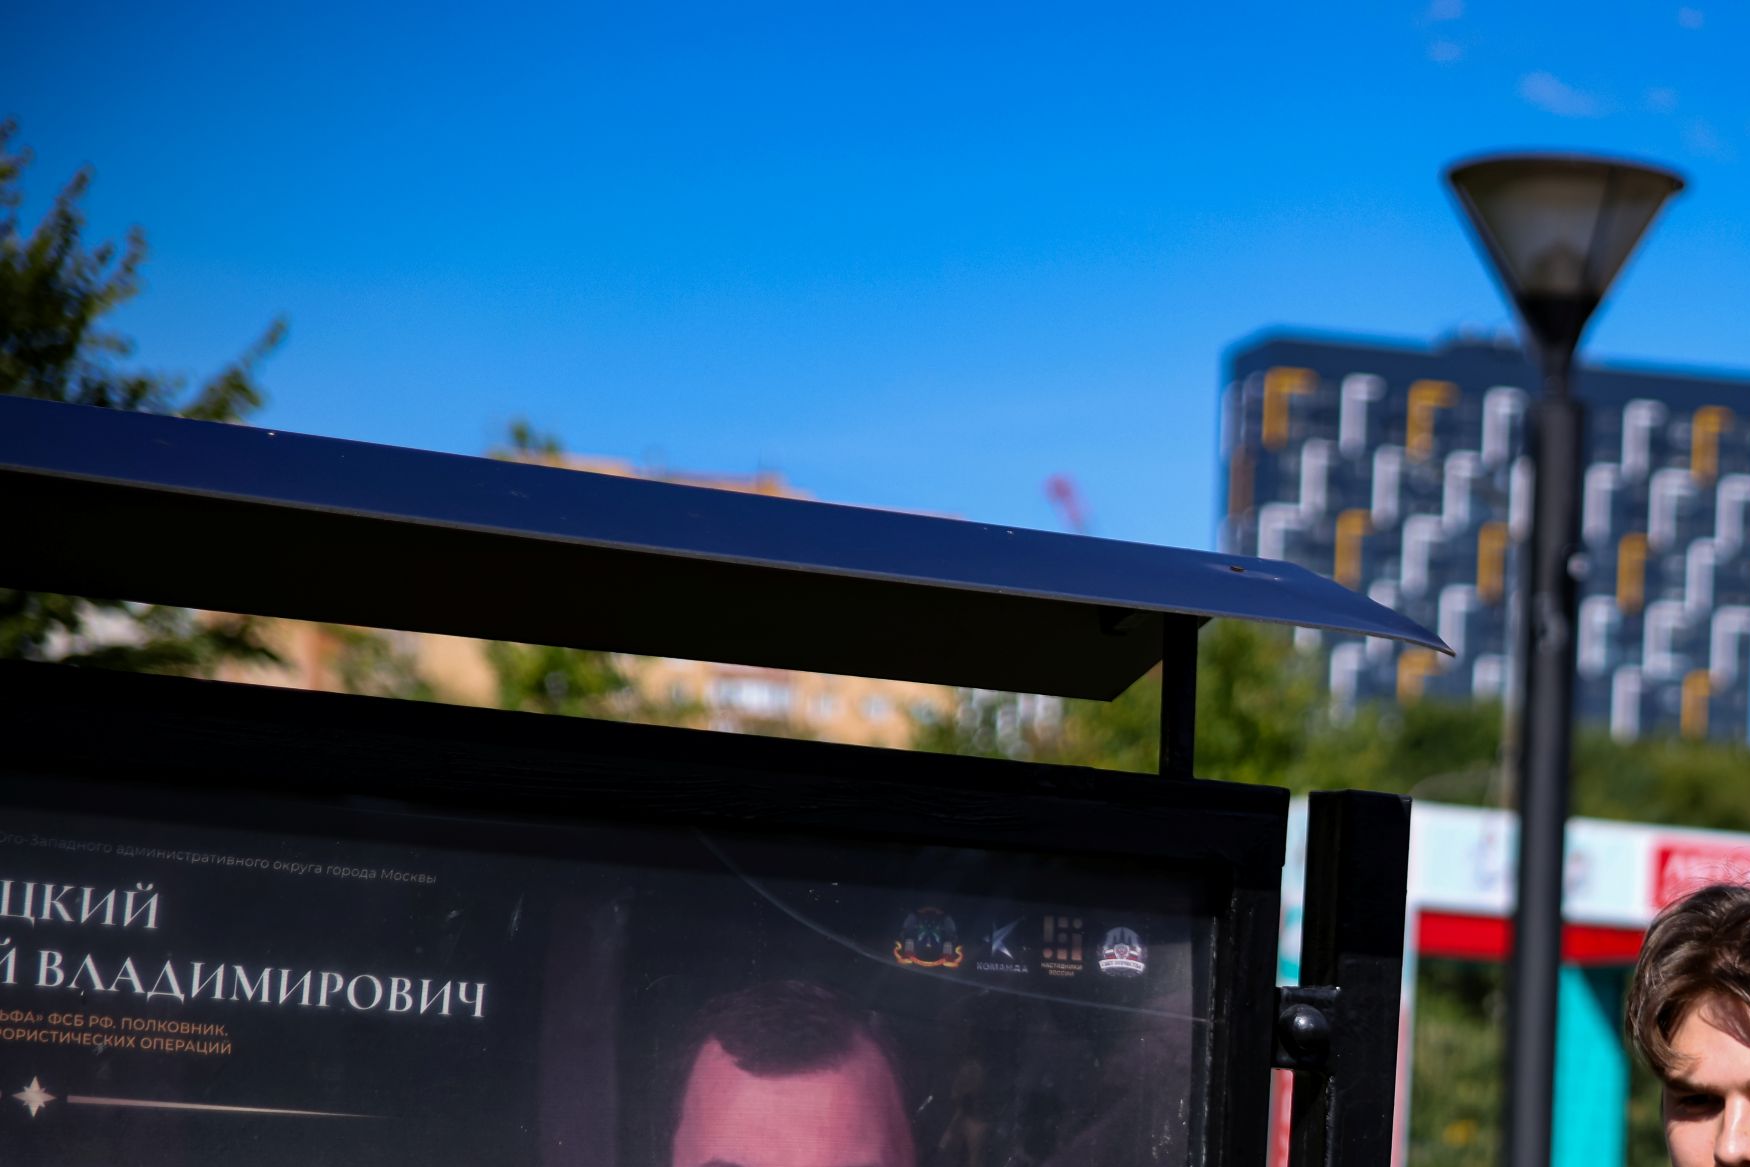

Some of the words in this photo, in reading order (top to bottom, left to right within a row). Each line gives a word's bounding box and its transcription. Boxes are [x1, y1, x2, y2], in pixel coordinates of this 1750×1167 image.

[116, 842, 269, 871] административного
[273, 860, 322, 877] округа
[326, 865, 376, 881] города
[380, 868, 437, 885] Москвы
[0, 880, 158, 928] ЦКИЙ
[35, 950, 485, 1017] ВЛАДИМИРОВИЧ
[48, 1013, 84, 1027] ФСБ
[89, 1016, 116, 1028] РФ.
[121, 1018, 228, 1036] ПОЛКОВНИК.
[140, 1037, 231, 1054] ОПЕРАЦИЙ
